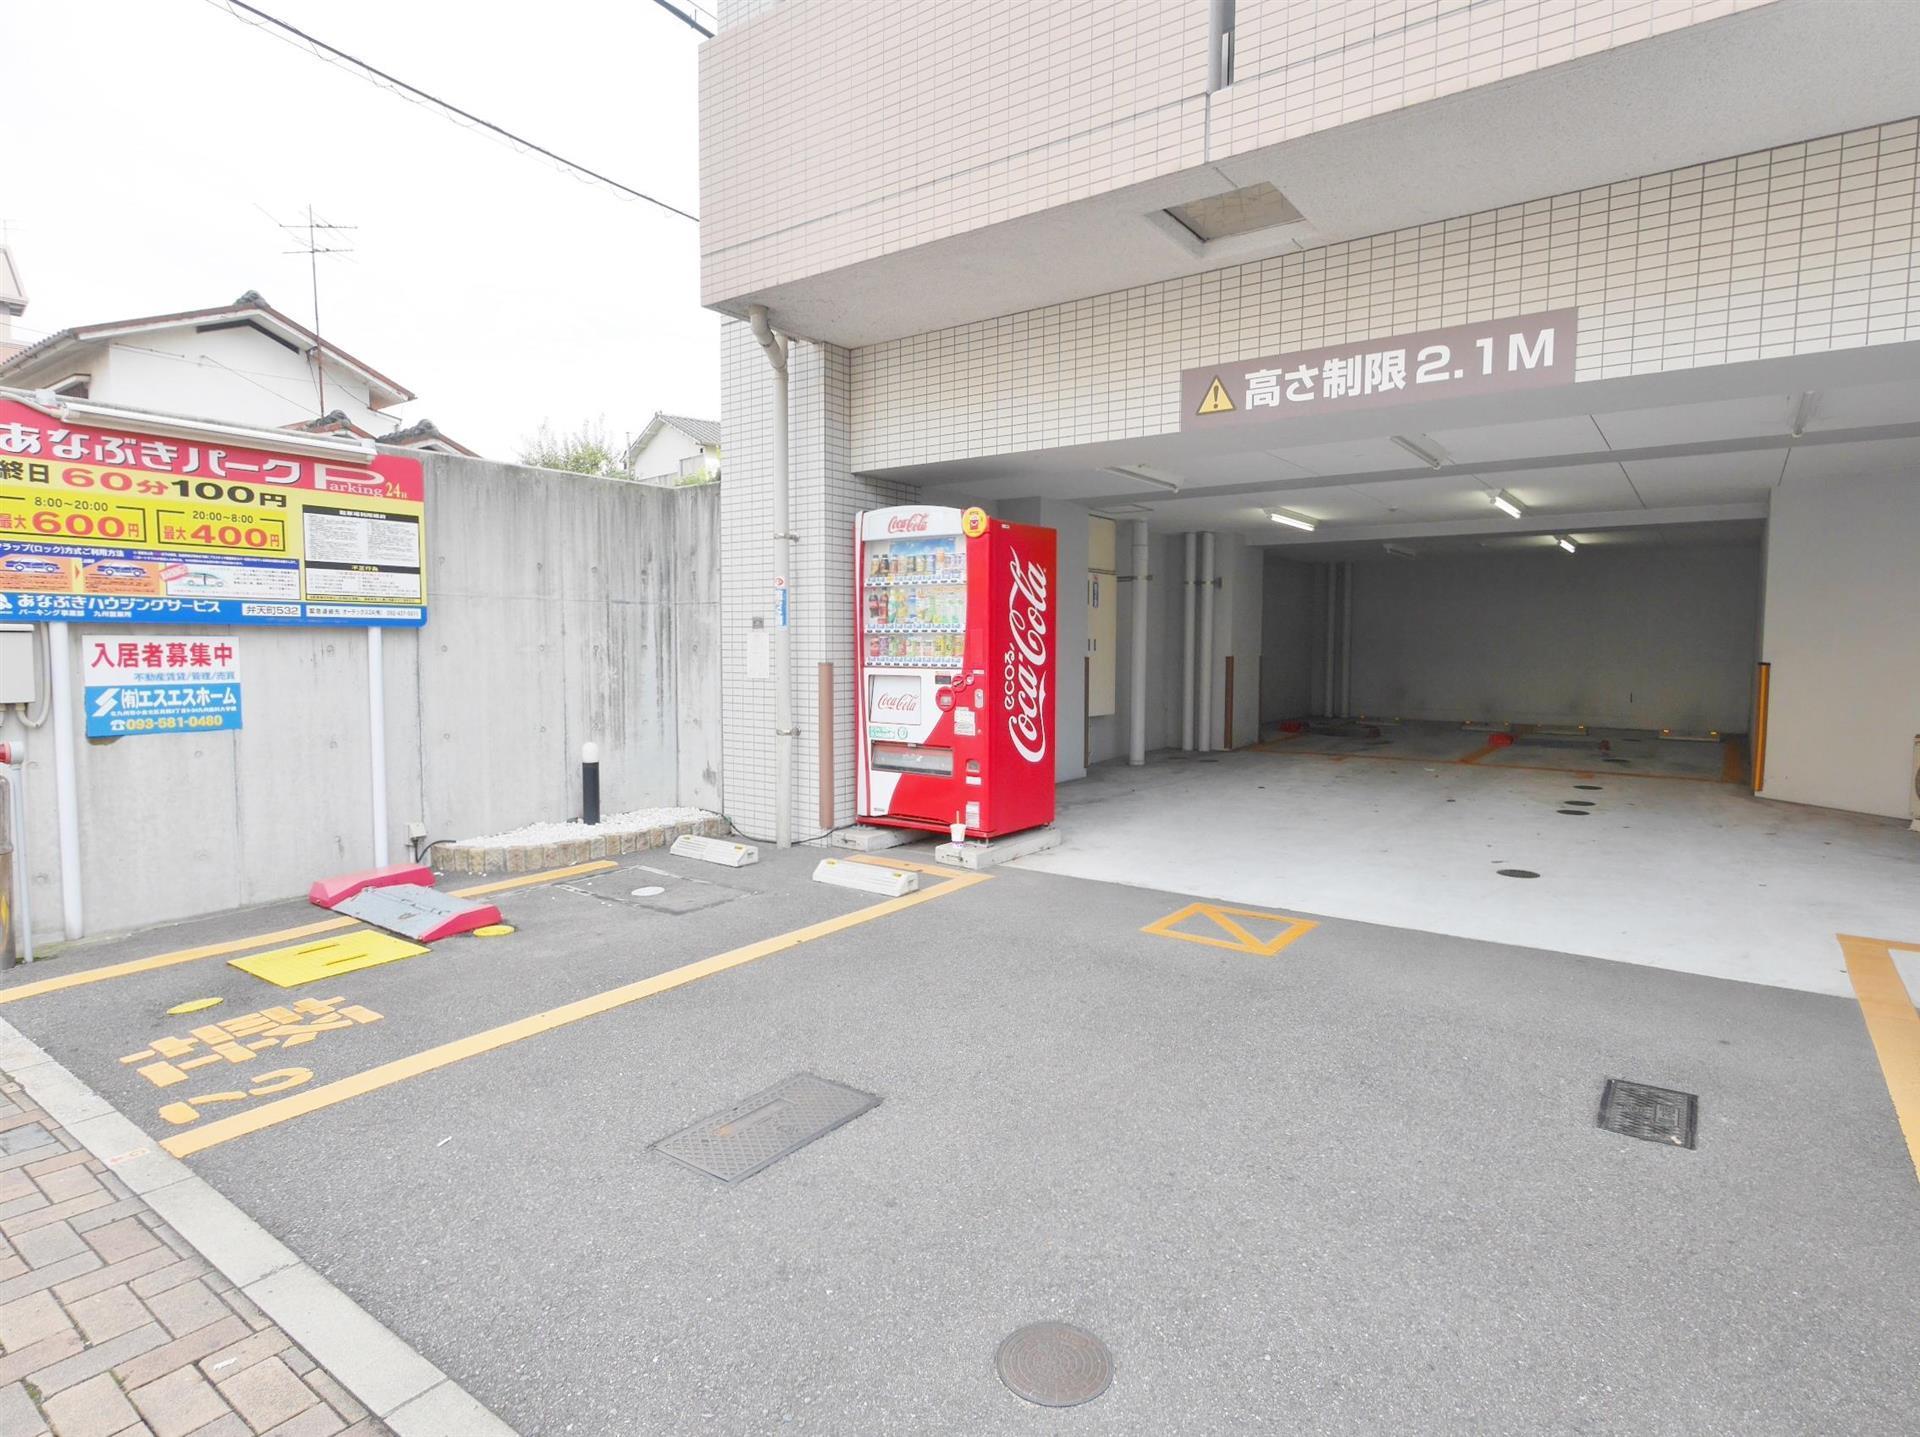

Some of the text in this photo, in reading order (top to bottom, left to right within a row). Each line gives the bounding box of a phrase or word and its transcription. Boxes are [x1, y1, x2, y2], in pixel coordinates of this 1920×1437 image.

[0, 421, 302, 485] あなぶきパーク
[313, 462, 385, 498] Parking
[0, 543, 125, 558] ラップ(ロック)方式ご利用方法
[17, 594, 220, 612] あなぶきハウジングサービス
[246, 606, 299, 616] 弁天町532
[91, 641, 233, 669] 入居者募集中
[1008, 545, 1048, 764] Coca-Cola
